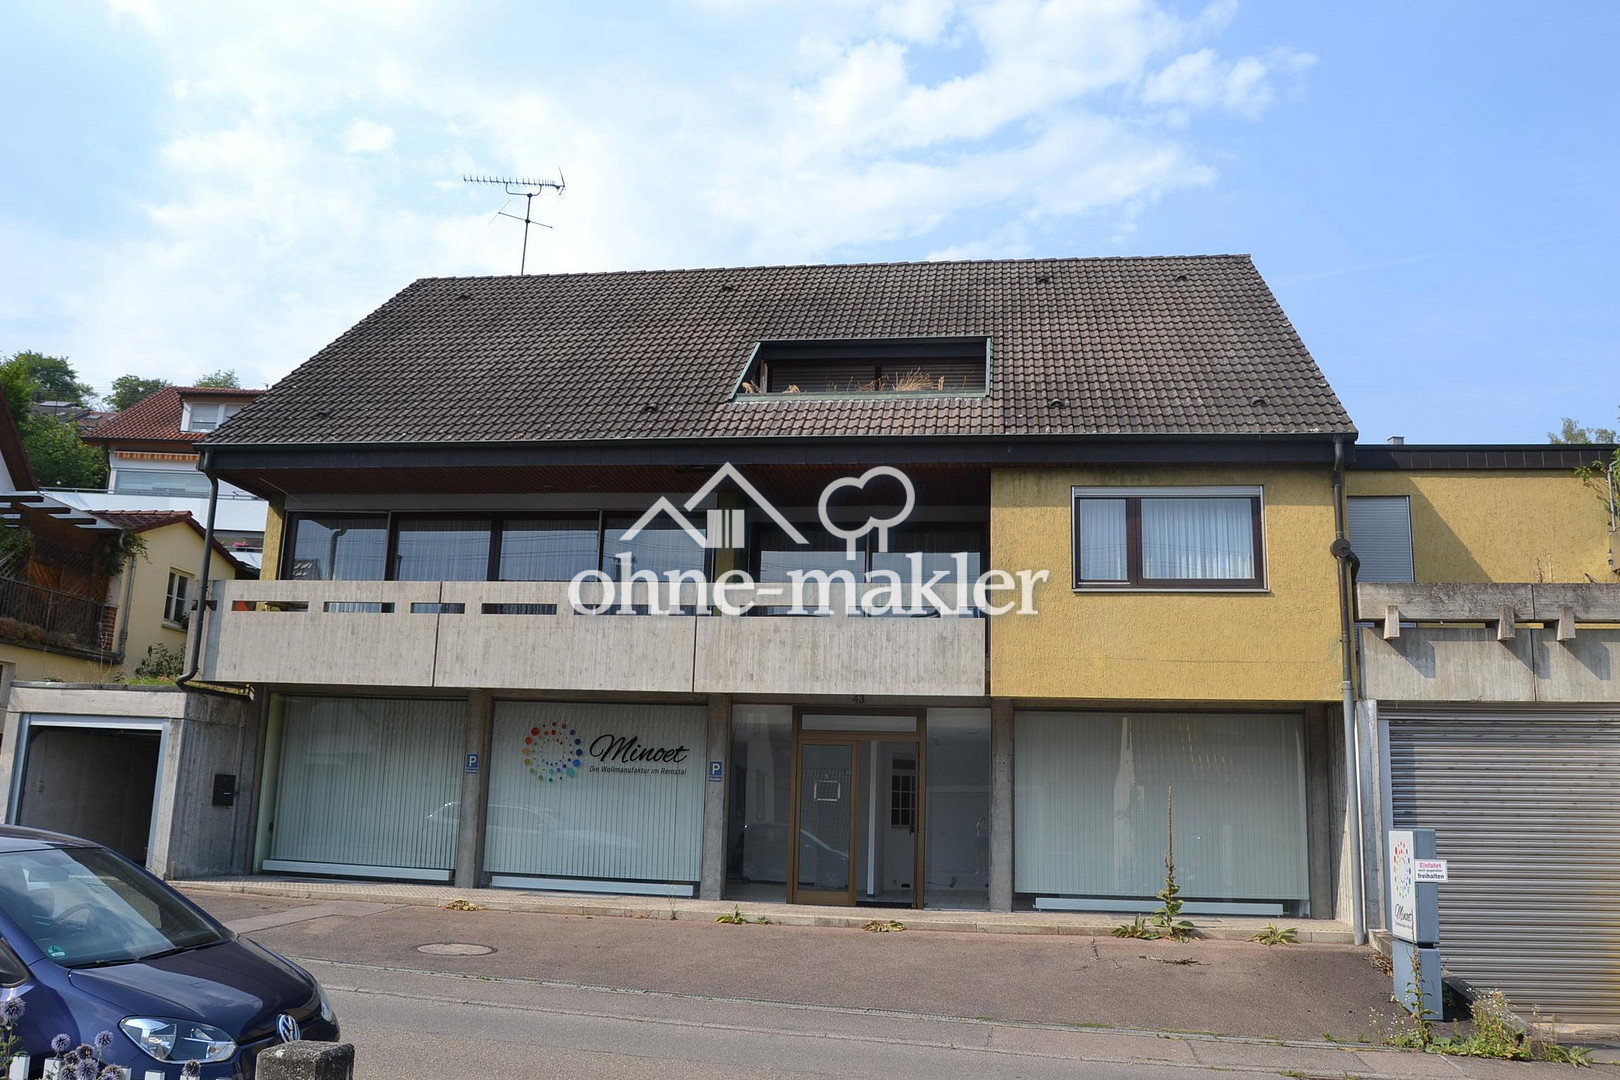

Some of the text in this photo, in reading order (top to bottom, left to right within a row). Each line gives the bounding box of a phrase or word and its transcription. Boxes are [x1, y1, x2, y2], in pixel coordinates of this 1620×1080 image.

[852, 695, 865, 704] 43
[589, 734, 690, 763] Minoet
[589, 765, 600, 773] Die
[601, 765, 649, 774] Wollmanufaktur
[660, 767, 687, 775] Remstal
